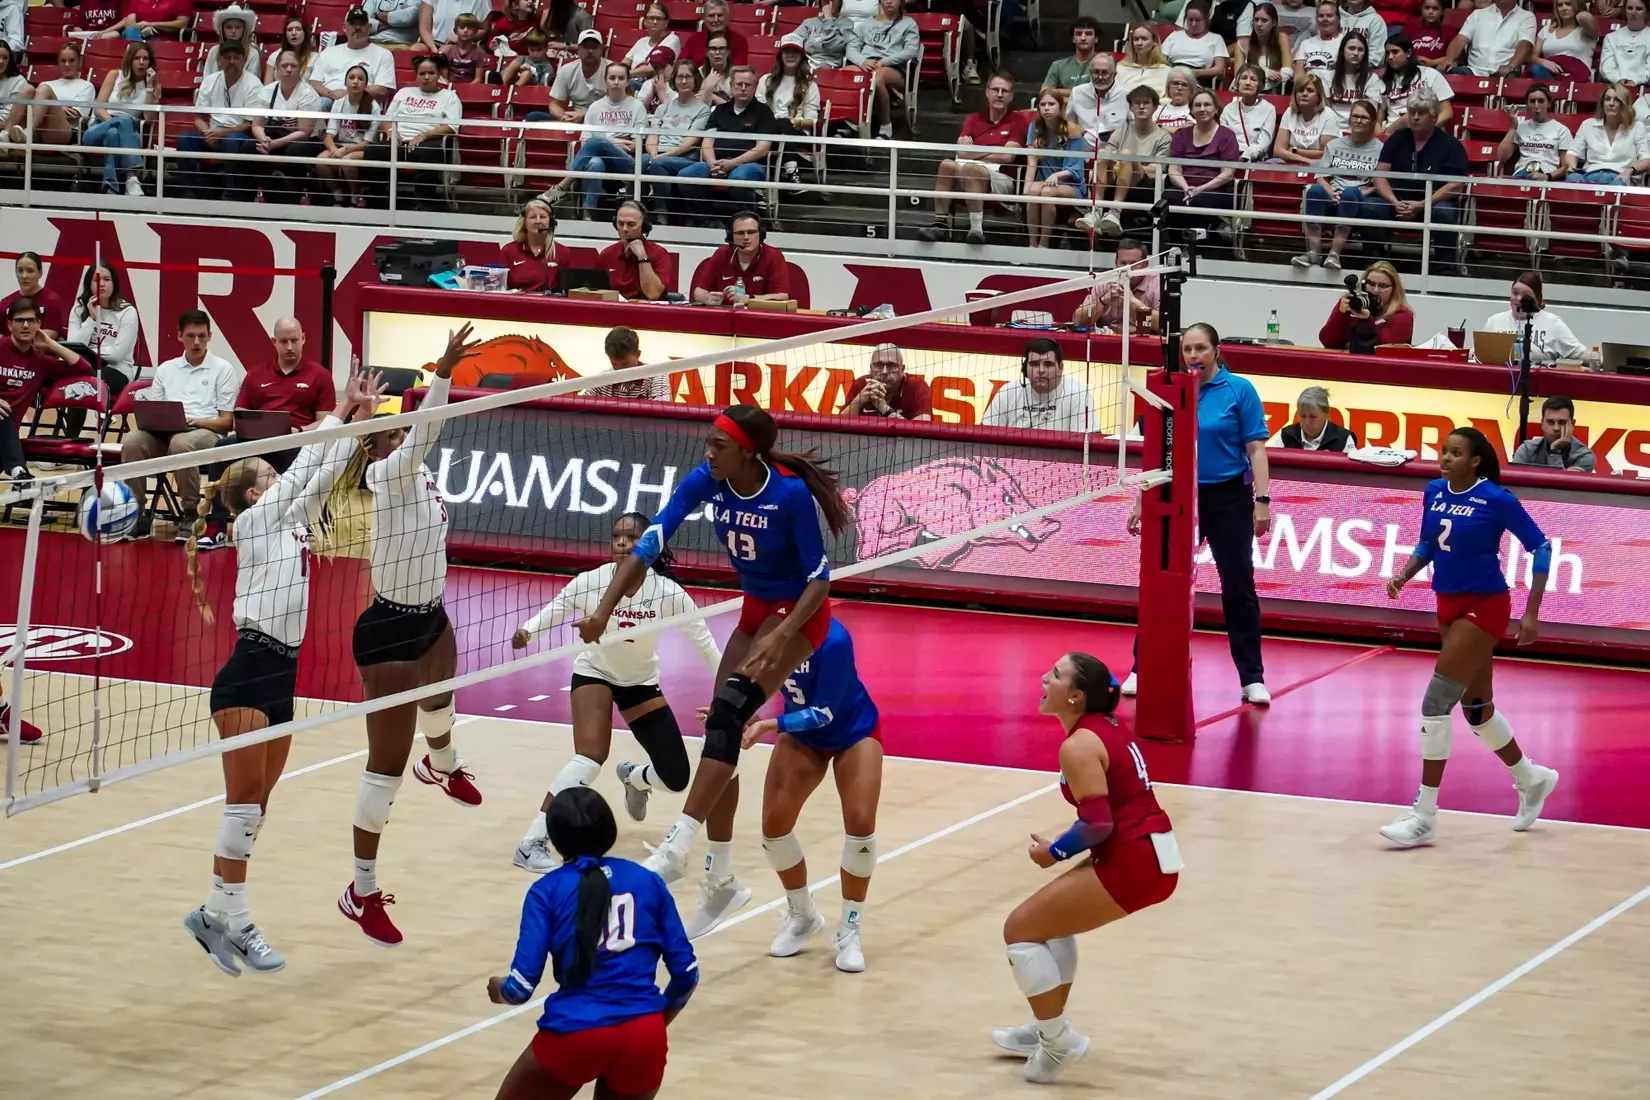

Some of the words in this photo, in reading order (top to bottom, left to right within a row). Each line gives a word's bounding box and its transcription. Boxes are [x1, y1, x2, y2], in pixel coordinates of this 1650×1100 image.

[866, 226, 876, 237] 5
[1165, 416, 1173, 446] sports
[735, 511, 768, 529] TECH
[1431, 501, 1446, 513] LA
[1446, 504, 1475, 517] TECH
[726, 530, 757, 561] 13
[1437, 518, 1452, 552] 2
[611, 609, 656, 620] KANSAS
[783, 678, 806, 705] 5
[598, 892, 636, 952] 0
